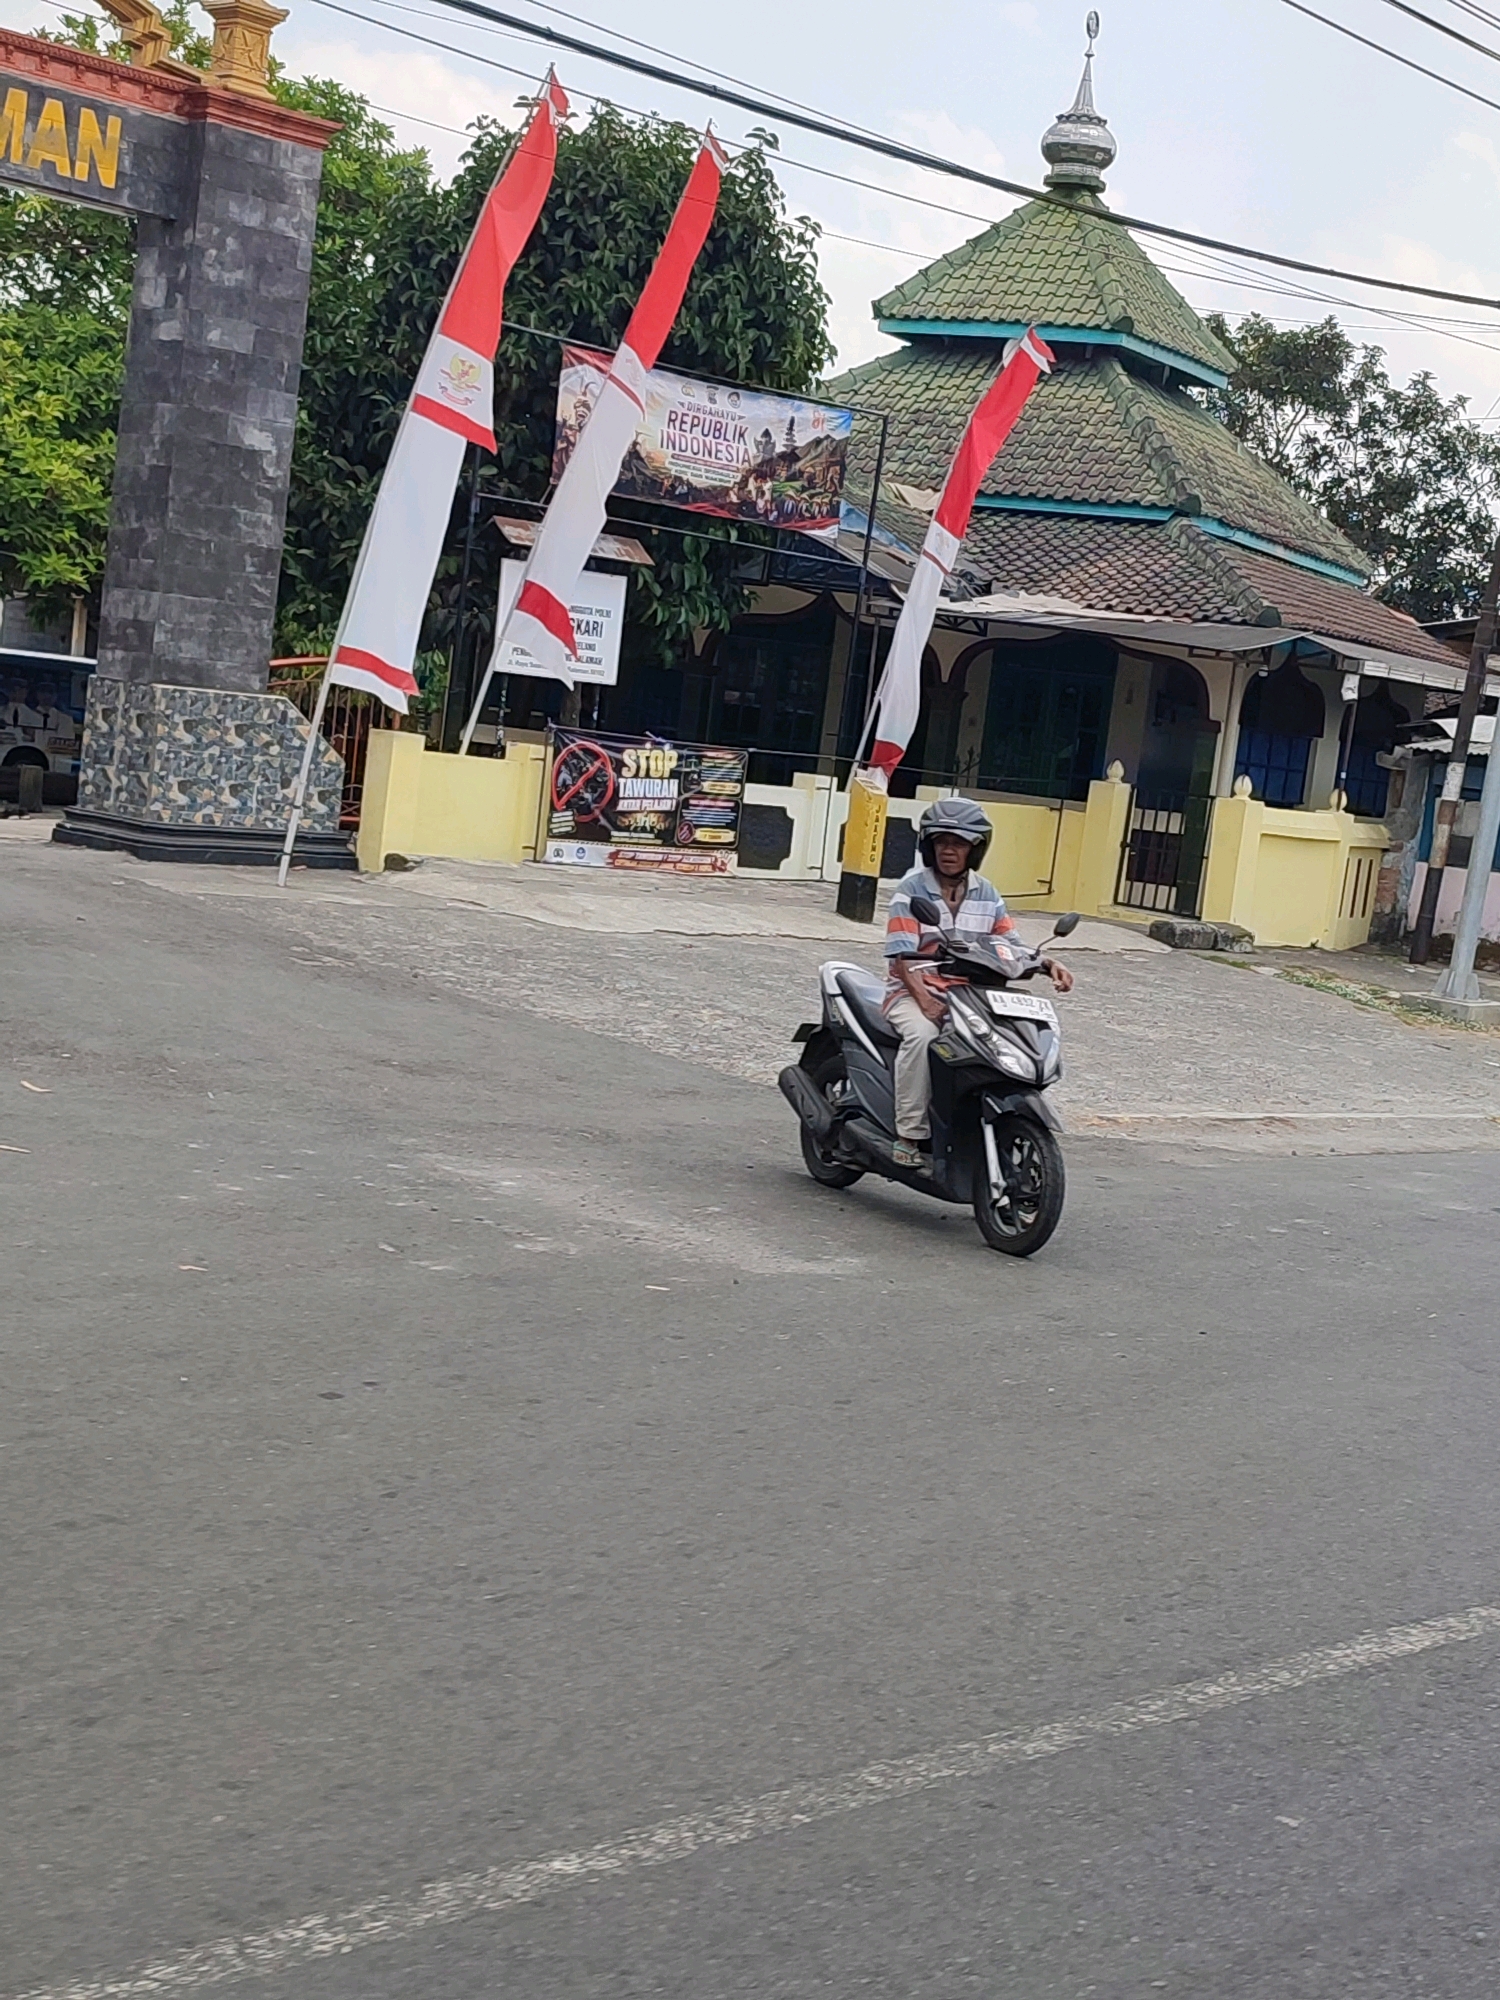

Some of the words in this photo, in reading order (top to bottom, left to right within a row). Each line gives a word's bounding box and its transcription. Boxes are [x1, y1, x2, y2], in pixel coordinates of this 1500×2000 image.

[686, 401, 737, 421] DIRGAHAYU
[667, 409, 749, 446] REPUBLIK
[660, 428, 752, 467] INDONESIA
[621, 749, 679, 778] STOP
[618, 778, 679, 798] TAWURAN
